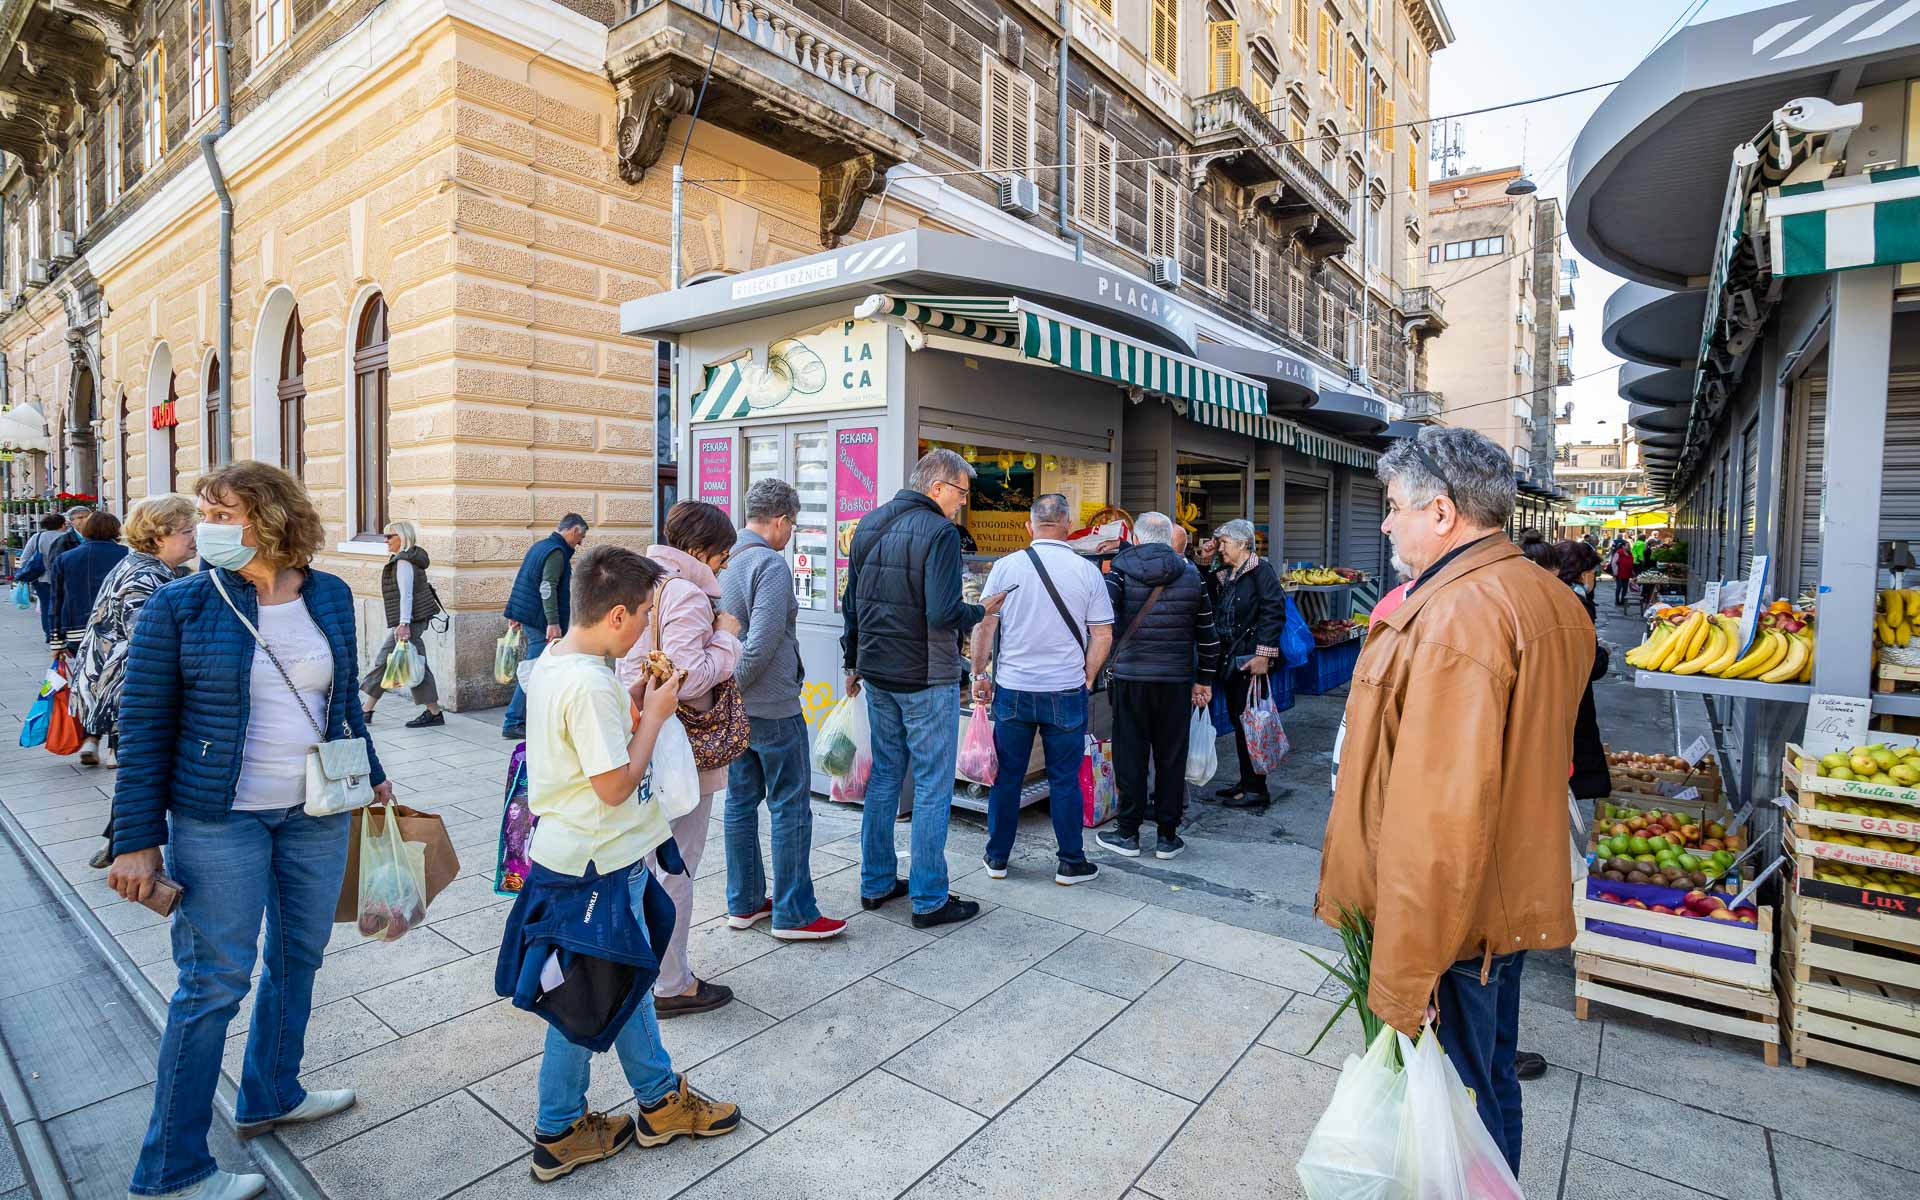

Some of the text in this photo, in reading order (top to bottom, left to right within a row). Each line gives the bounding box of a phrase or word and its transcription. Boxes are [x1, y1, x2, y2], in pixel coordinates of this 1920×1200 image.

[1098, 276, 1159, 316] PLACA
[840, 432, 874, 444] PEKARA
[703, 442, 729, 453] PEKARA
[970, 520, 1026, 530] STOGODIŠNJ
[976, 533, 1025, 543] KVALITETA
[1843, 782, 1895, 798] Frutta
[1861, 890, 1907, 911] Lux
